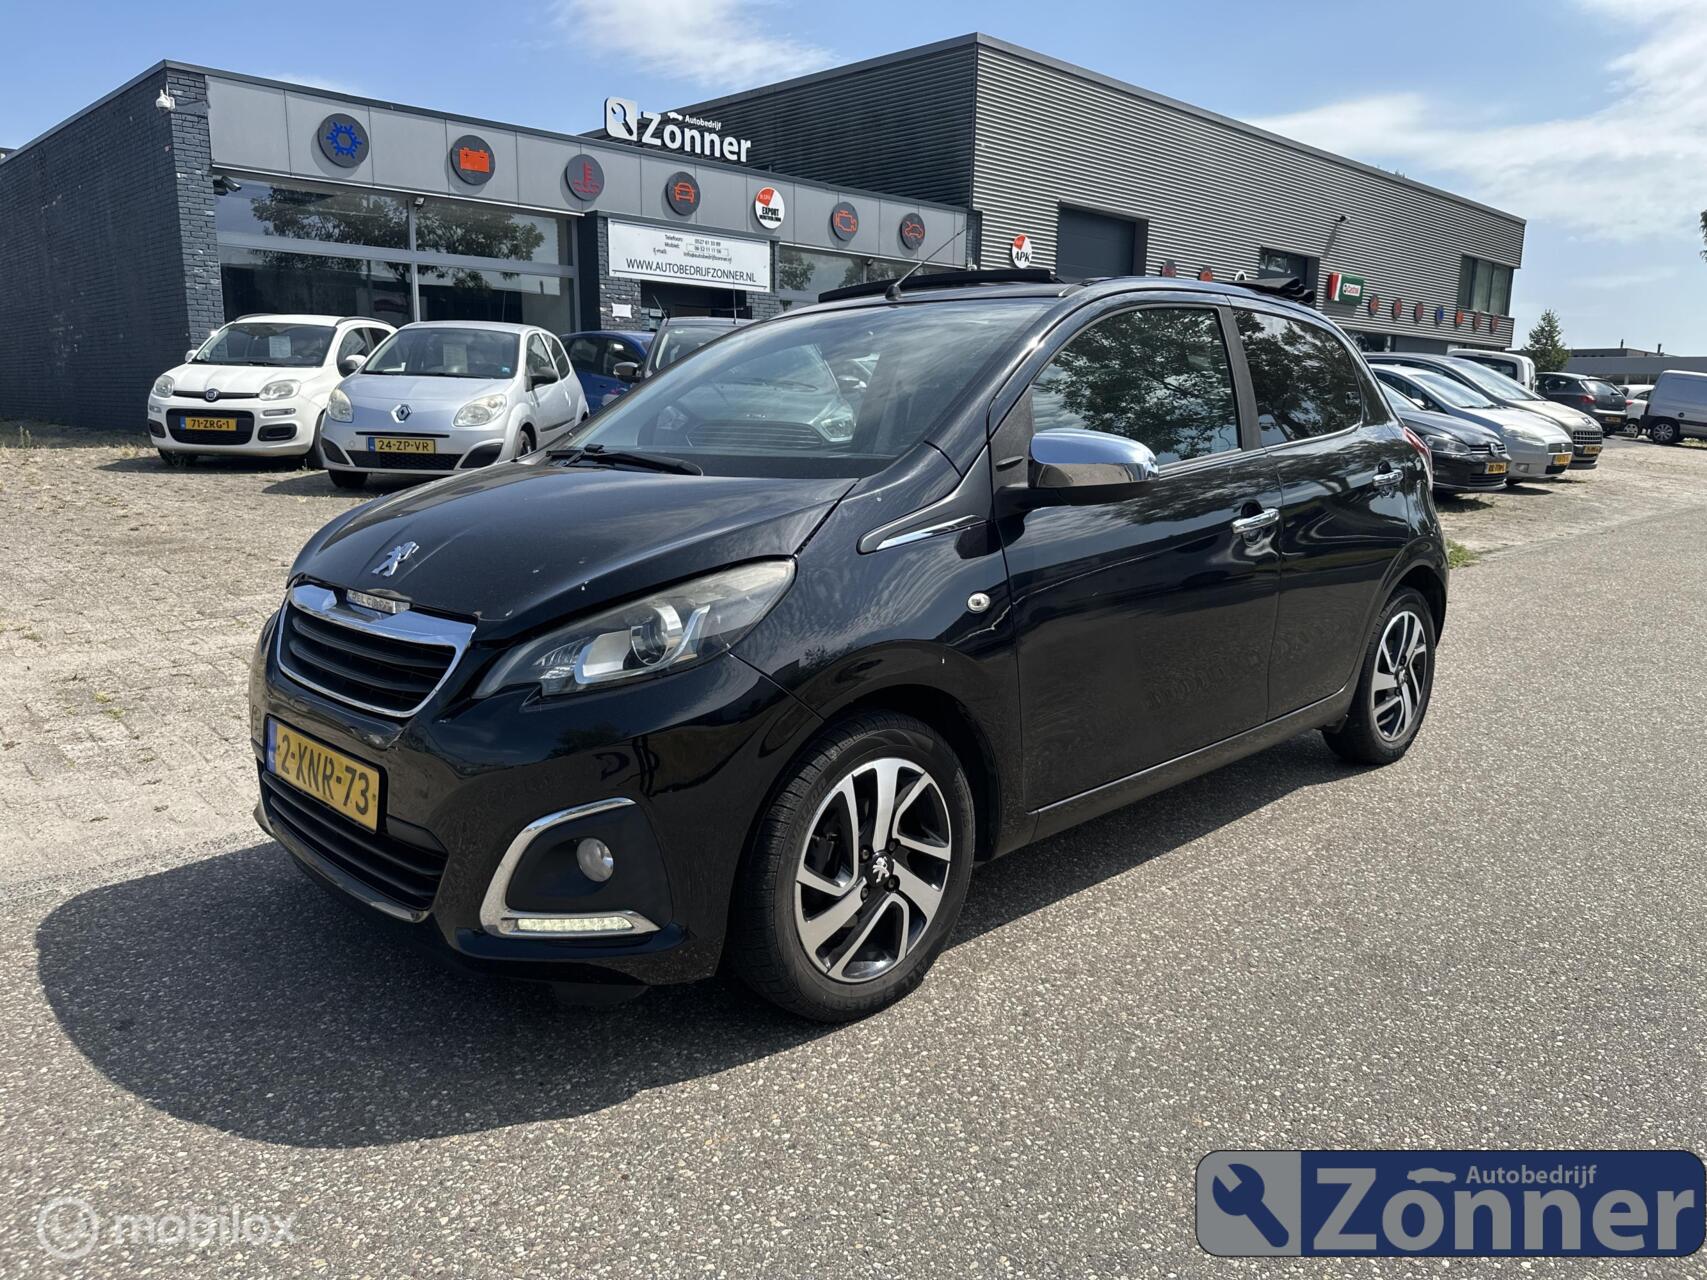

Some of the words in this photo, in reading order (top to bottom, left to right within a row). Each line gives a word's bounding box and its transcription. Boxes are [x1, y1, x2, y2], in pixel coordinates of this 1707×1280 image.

[684, 114, 722, 131] Autobedrijf
[641, 111, 752, 163] Zonner
[1015, 250, 1031, 262] APK
[626, 257, 757, 283] WWW.AUTOBEDRIJFZONNER.NL
[191, 418, 230, 429] 71-ZRG-1
[378, 440, 429, 452] 24-ZP-VR
[281, 734, 370, 816] 2-XNR-73
